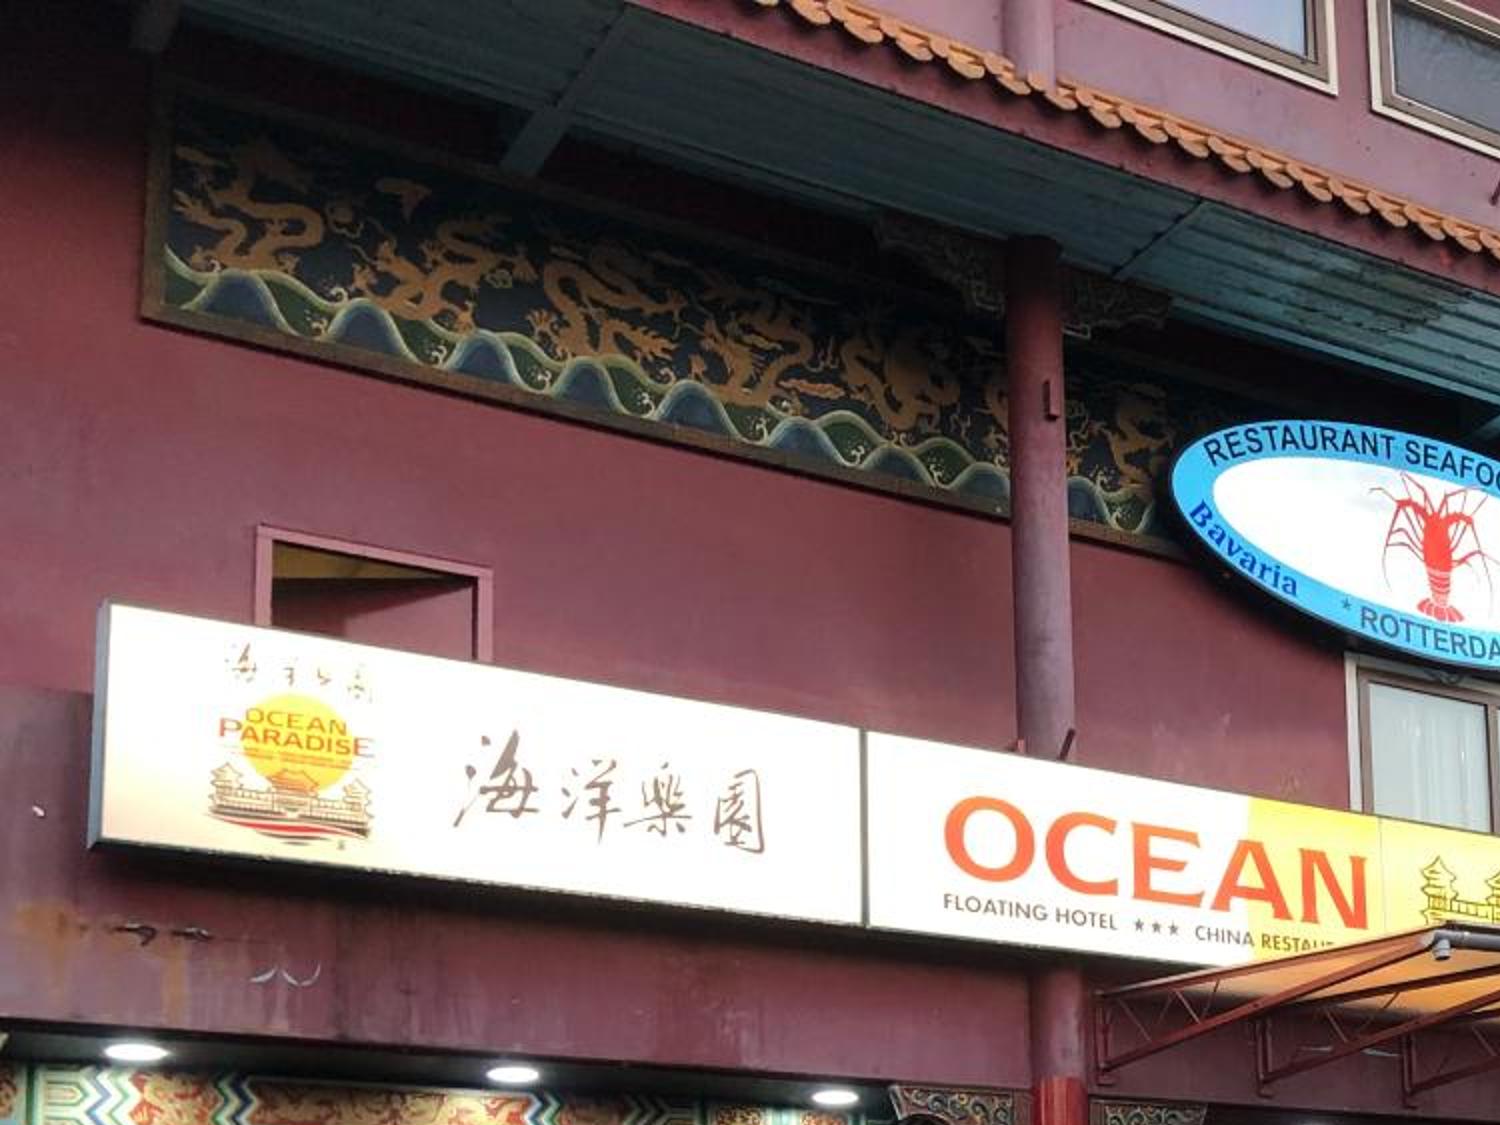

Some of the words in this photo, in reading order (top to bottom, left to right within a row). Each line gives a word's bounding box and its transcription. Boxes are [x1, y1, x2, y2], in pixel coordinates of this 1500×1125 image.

[1203, 423, 1396, 467] RESTAURANT
[1188, 500, 1298, 598] Bavaria
[219, 717, 376, 759] PARADISE
[245, 707, 348, 737] OCEAN
[943, 796, 1370, 931] OCEAN
[943, 893, 1049, 922] FLOATING
[1055, 907, 1118, 931] HOTEL
[1195, 925, 1256, 948] CHINA
